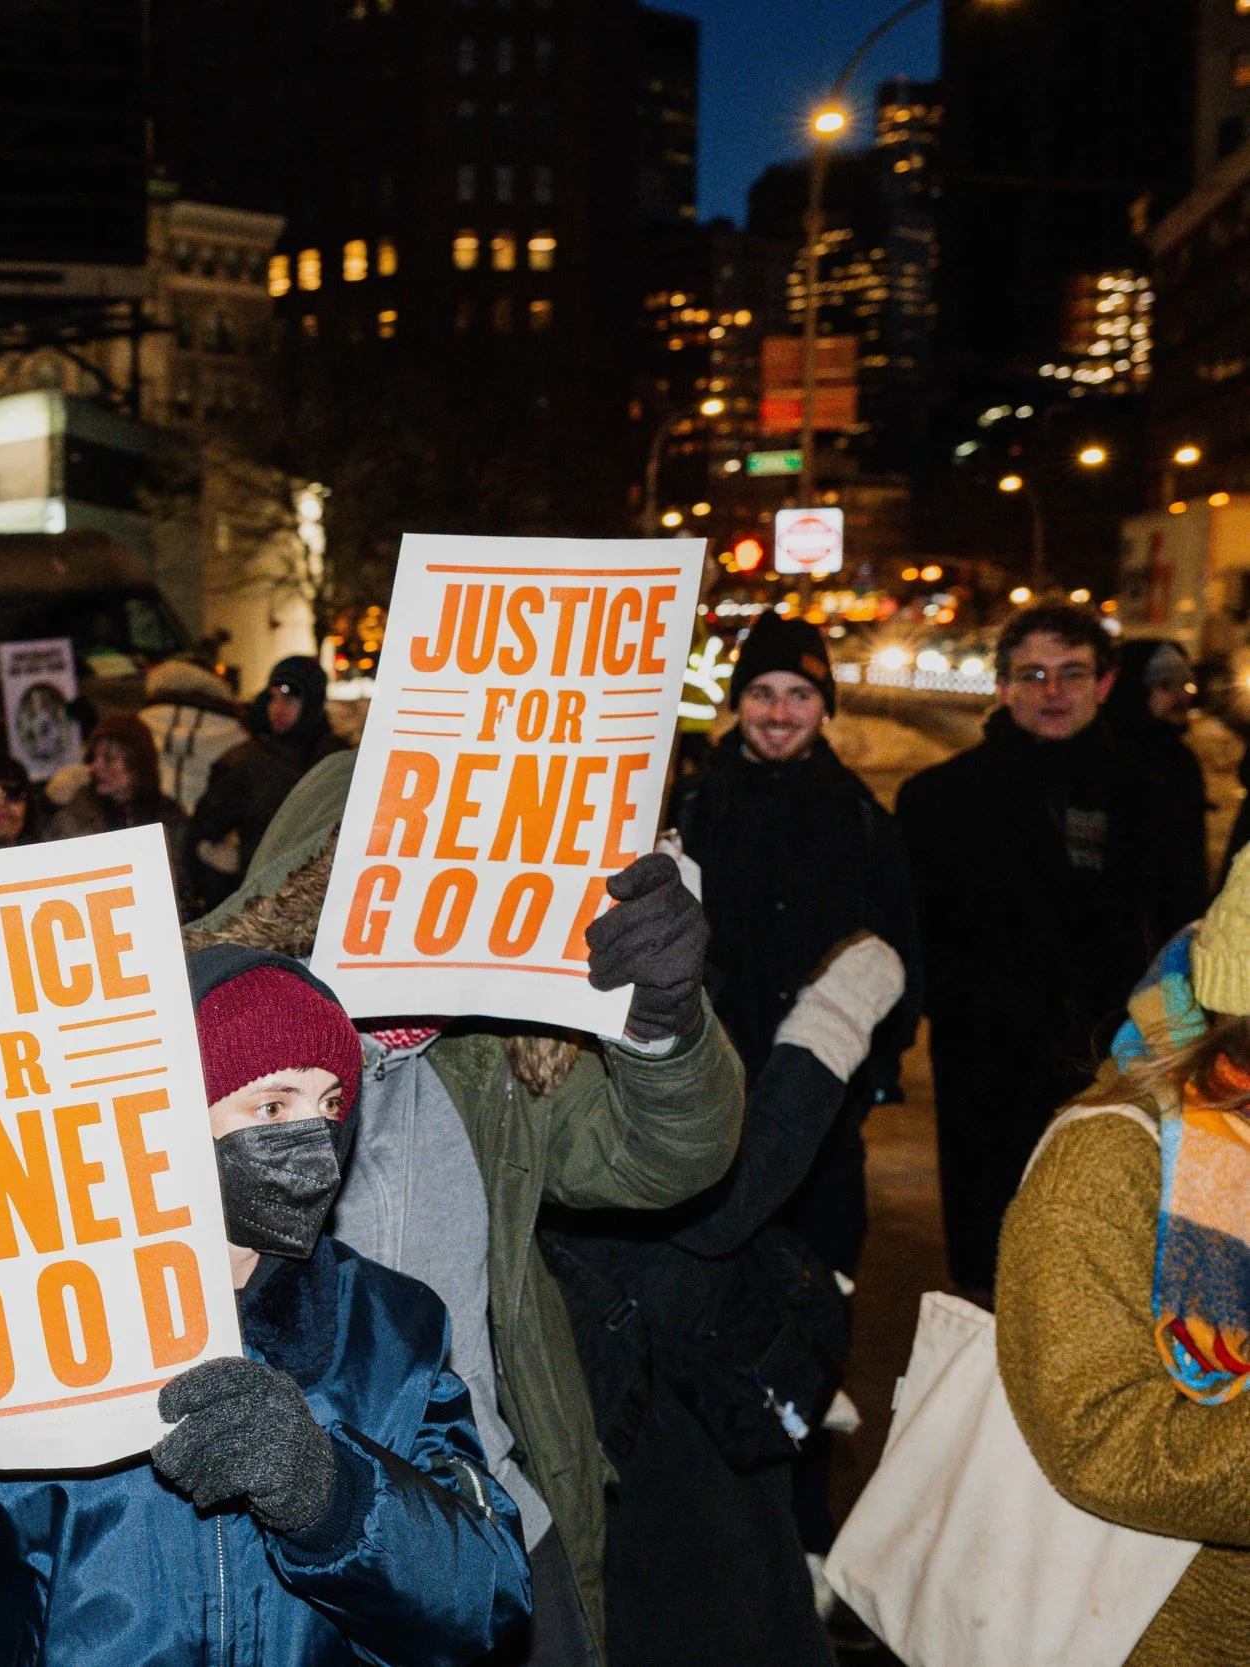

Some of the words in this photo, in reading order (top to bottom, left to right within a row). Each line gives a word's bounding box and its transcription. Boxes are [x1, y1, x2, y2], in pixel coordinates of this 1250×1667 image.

[410, 583, 677, 677] JUSTICE
[476, 687, 587, 744] FOR
[365, 749, 651, 870] RENEE
